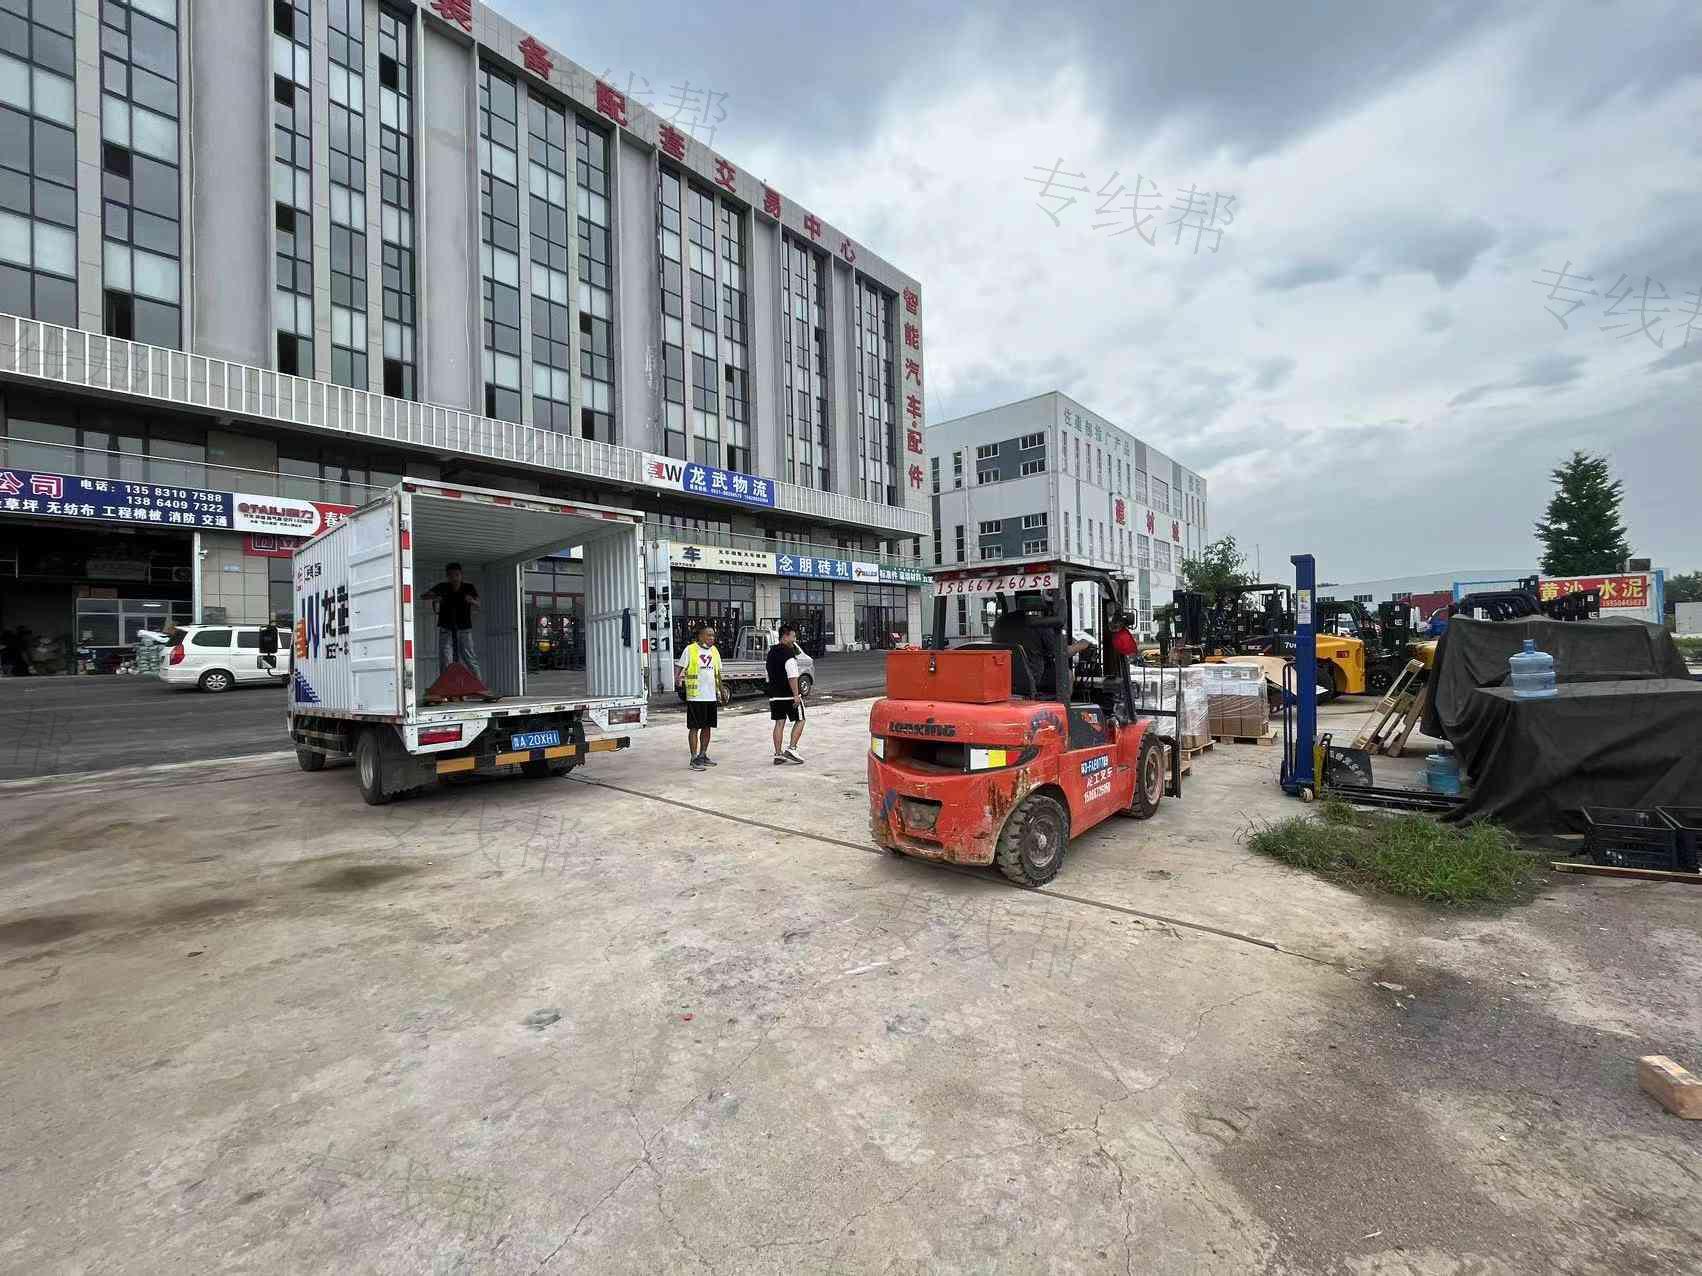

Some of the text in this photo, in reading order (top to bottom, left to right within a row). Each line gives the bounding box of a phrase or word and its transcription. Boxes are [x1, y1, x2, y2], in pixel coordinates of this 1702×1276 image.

[0, 471, 64, 499] 公司
[689, 466, 768, 498] 龙武物流
[125, 484, 154, 496] 135
[155, 486, 187, 499] 8310
[191, 491, 223, 503] 7588
[0, 498, 39, 513] 草坪
[46, 501, 96, 517] 无纺布
[169, 510, 196, 525] 消防
[202, 514, 228, 528] 交通
[126, 495, 225, 513] 138 6409 7322
[681, 546, 702, 563] 车
[778, 555, 849, 577] 念朋砖机
[937, 575, 1052, 595] 15866726058
[1597, 579, 1644, 599] 水泥
